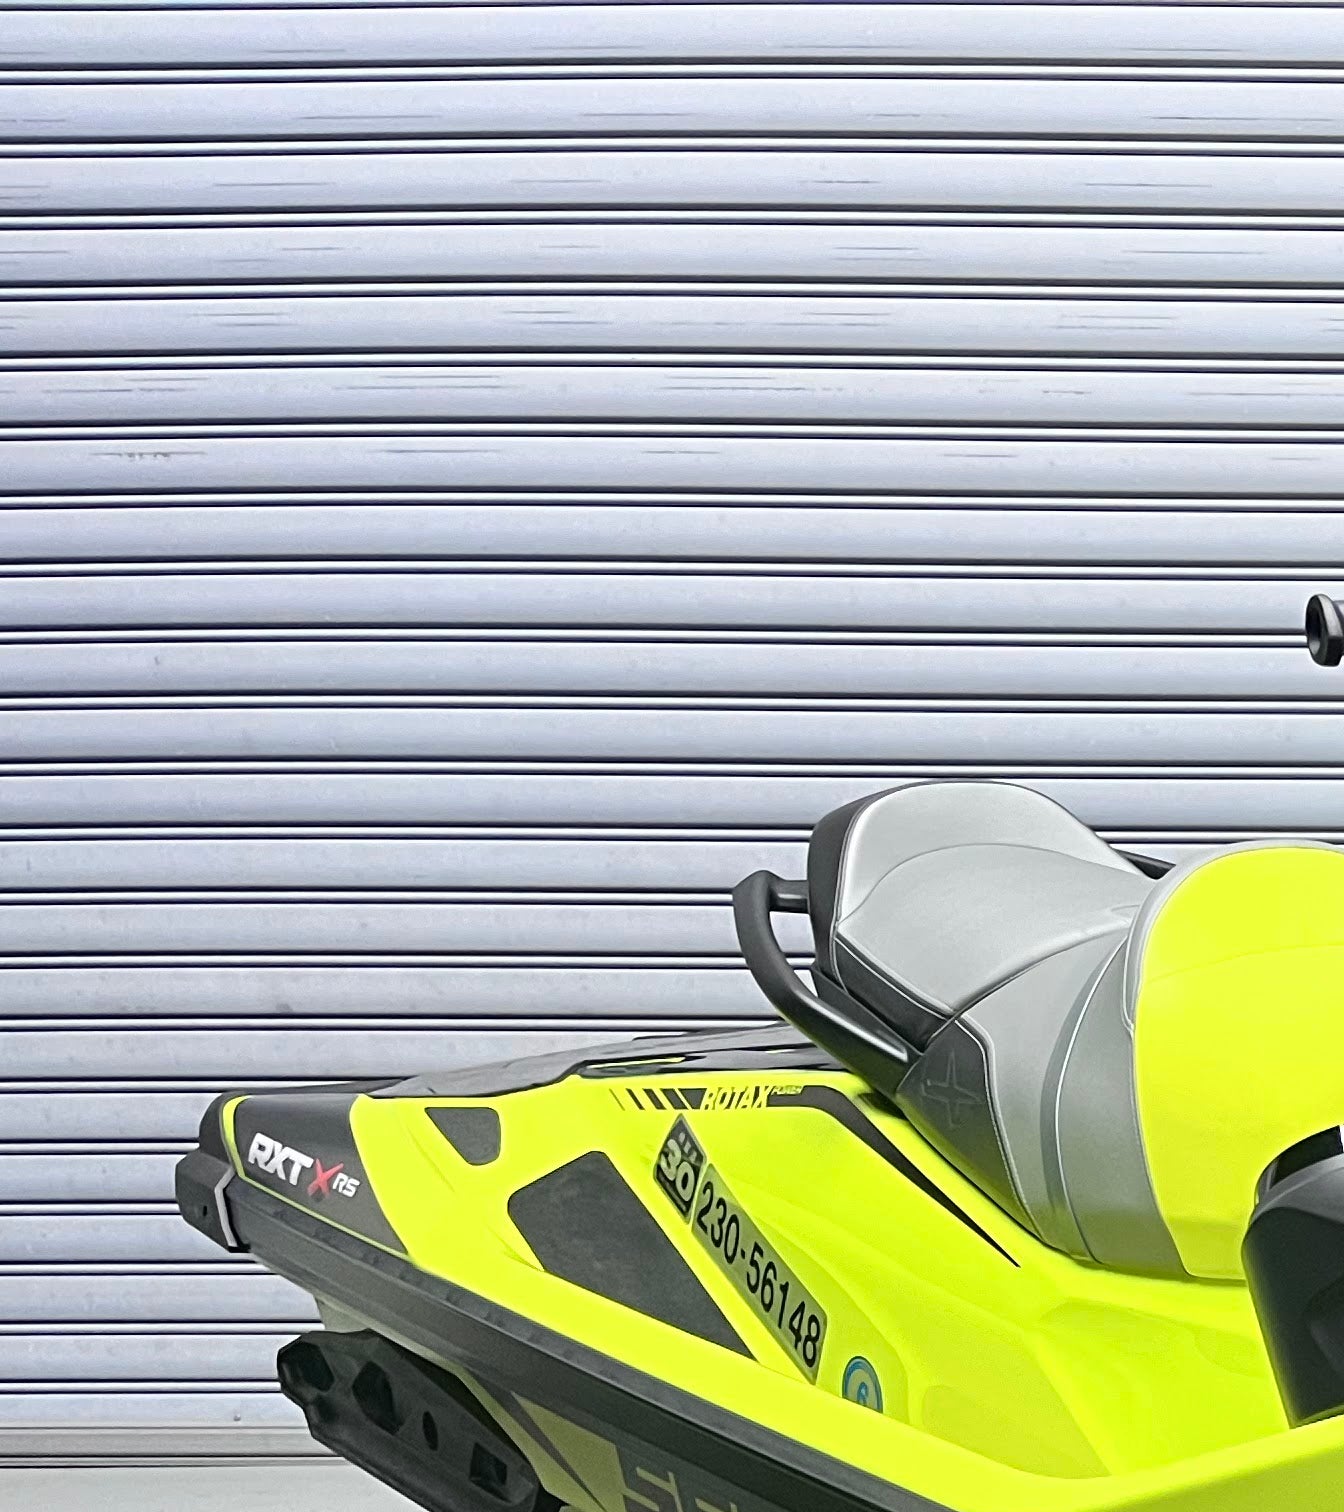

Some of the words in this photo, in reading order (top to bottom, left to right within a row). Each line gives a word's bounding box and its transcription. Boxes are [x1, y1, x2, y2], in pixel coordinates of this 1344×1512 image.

[700, 1086, 769, 1110] ROTAX
[248, 1132, 314, 1186] RXT
[332, 1173, 360, 1197] RS
[660, 1138, 695, 1201] 30
[697, 1181, 821, 1367] 230-56148
